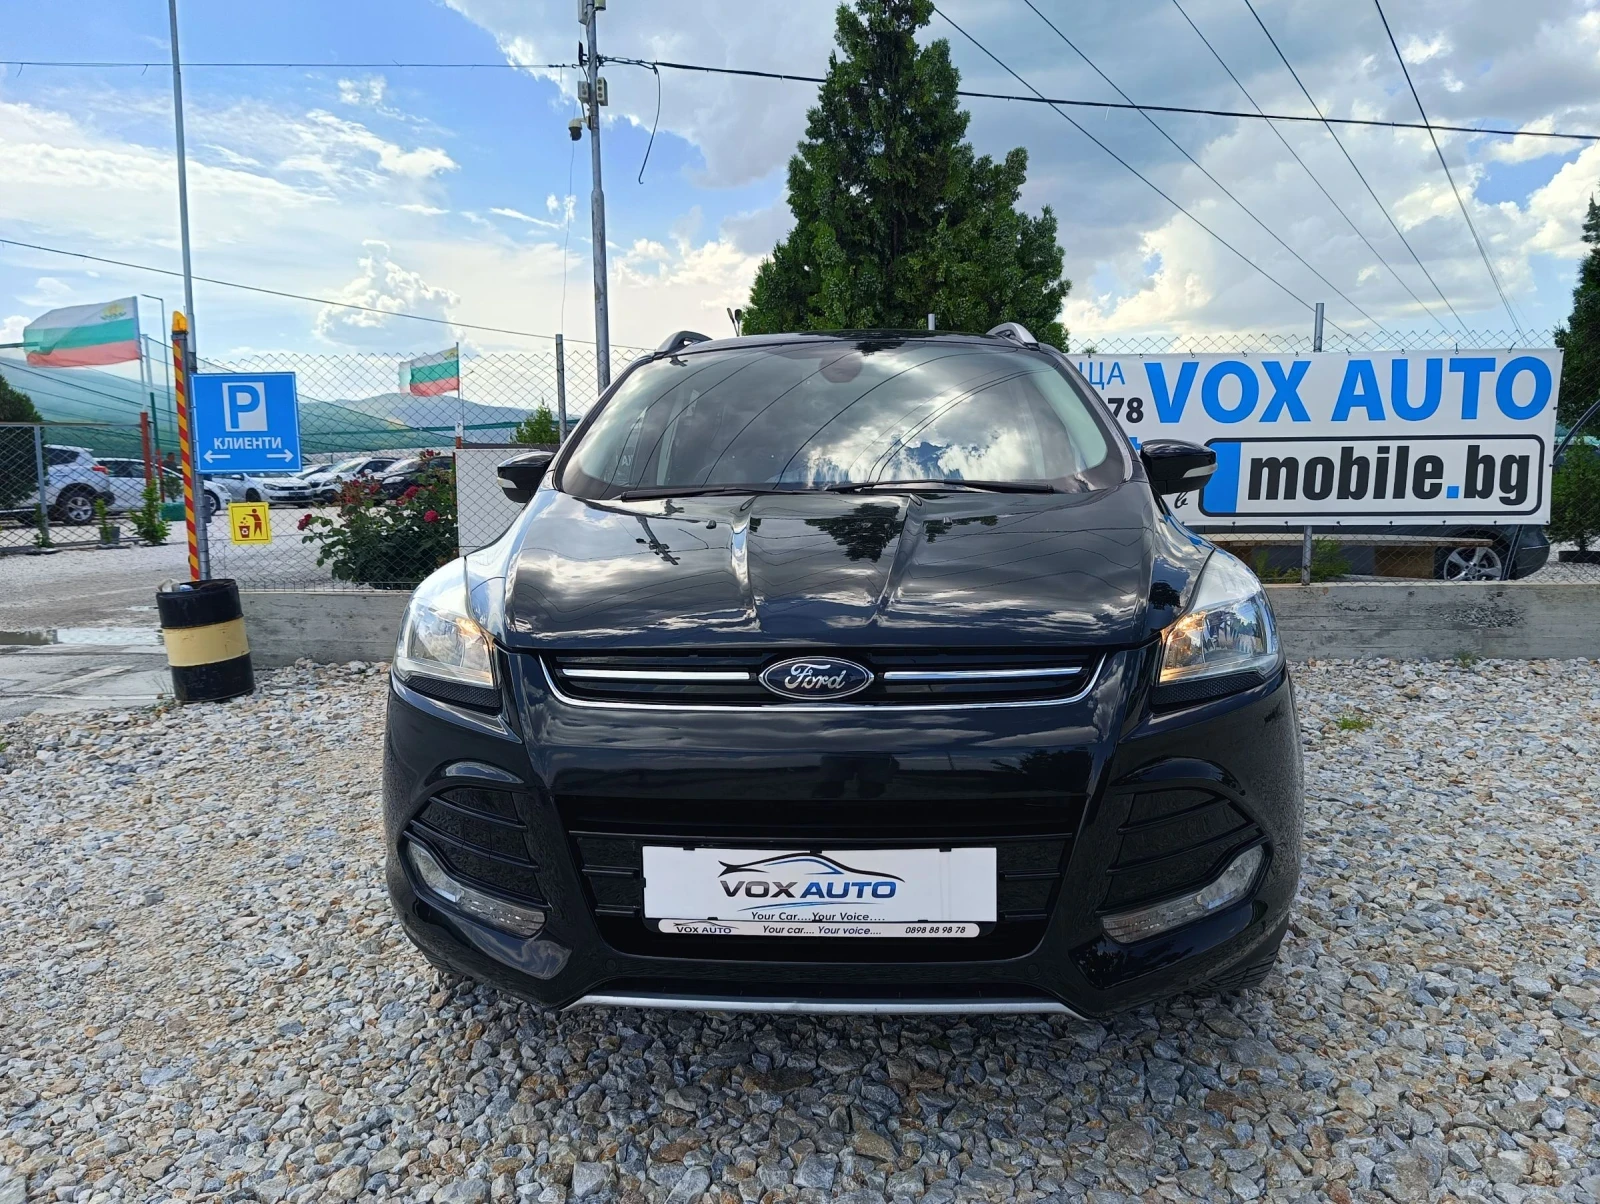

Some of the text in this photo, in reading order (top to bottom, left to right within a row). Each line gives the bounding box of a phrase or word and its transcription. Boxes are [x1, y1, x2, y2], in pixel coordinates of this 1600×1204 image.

[1079, 361, 1125, 390] ЩА
[1144, 356, 1552, 424] VOX AUTO
[227, 384, 261, 429] P
[214, 437, 282, 450] КЛИЕНТИ
[1248, 444, 1530, 506] mobile.bg
[784, 663, 847, 689] Ford
[720, 880, 897, 899] VOX AUTO
[751, 911, 775, 921] Your
[676, 926, 699, 934] VOX
[763, 925, 785, 934] Your
[818, 926, 840, 935] Your
[905, 926, 966, 934] 0898 88 98 78
